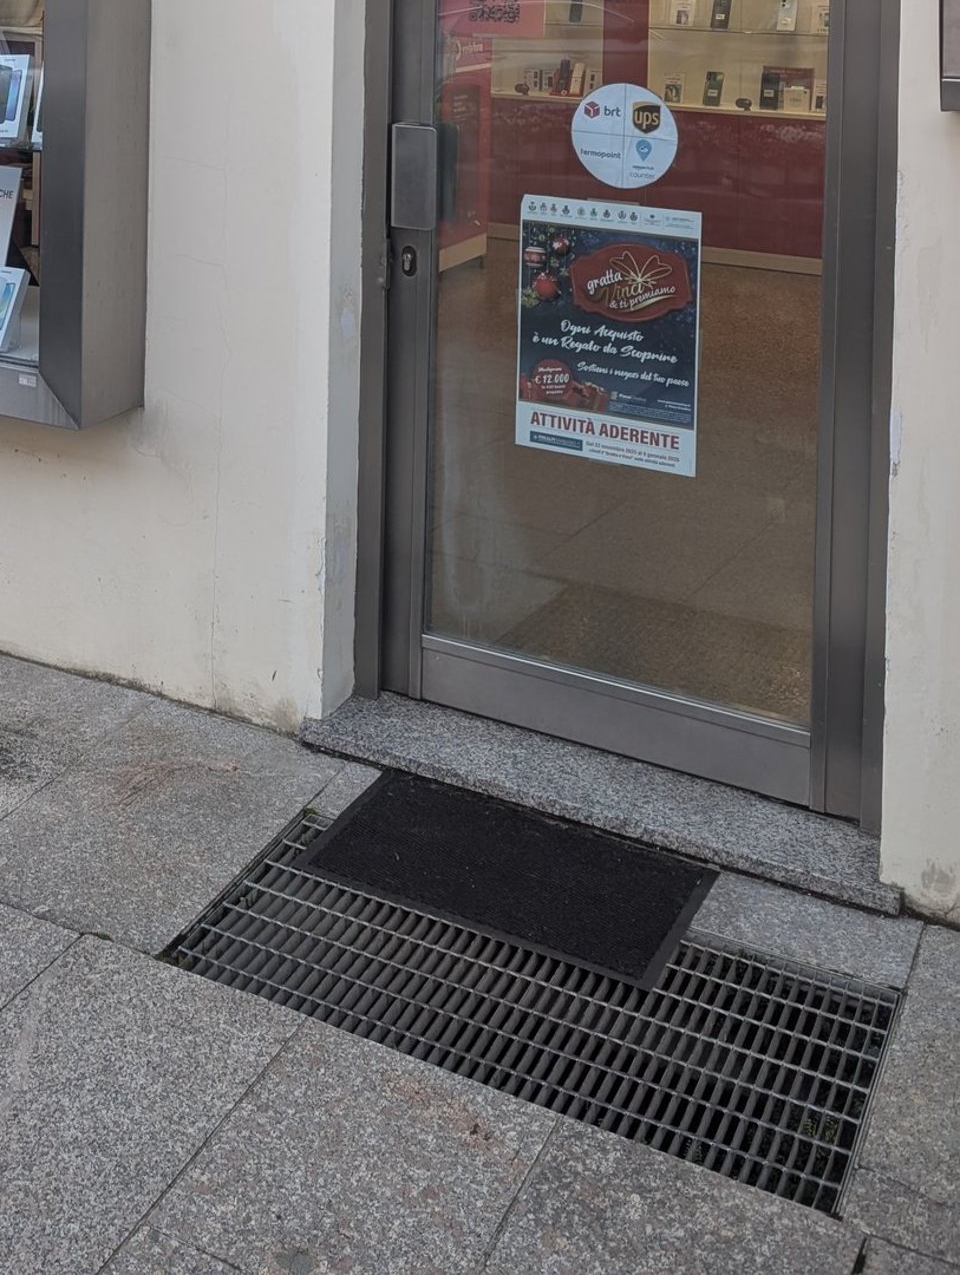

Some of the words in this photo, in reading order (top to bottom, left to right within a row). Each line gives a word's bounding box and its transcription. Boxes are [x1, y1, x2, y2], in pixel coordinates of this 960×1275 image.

[604, 106, 621, 117] brt
[634, 111, 659, 130] ups
[586, 269, 622, 294] gratta
[599, 281, 644, 306] Vinci
[609, 300, 618, 309] &
[619, 298, 629, 309] ti
[629, 286, 676, 311] premiamo
[561, 319, 591, 334] Ogni
[593, 325, 644, 342] Acquisto
[532, 332, 540, 343] è
[542, 337, 559, 346] un
[561, 336, 601, 352] Regalo
[603, 343, 618, 355] da
[620, 345, 678, 364] Scoprire
[535, 376, 541, 384] €
[577, 361, 608, 375] Sostieni
[640, 370, 653, 382] del
[653, 372, 665, 383] tuo
[666, 377, 690, 388] paese
[530, 411, 595, 435] ATTIVITÀ
[599, 423, 680, 450] ADERENTE
